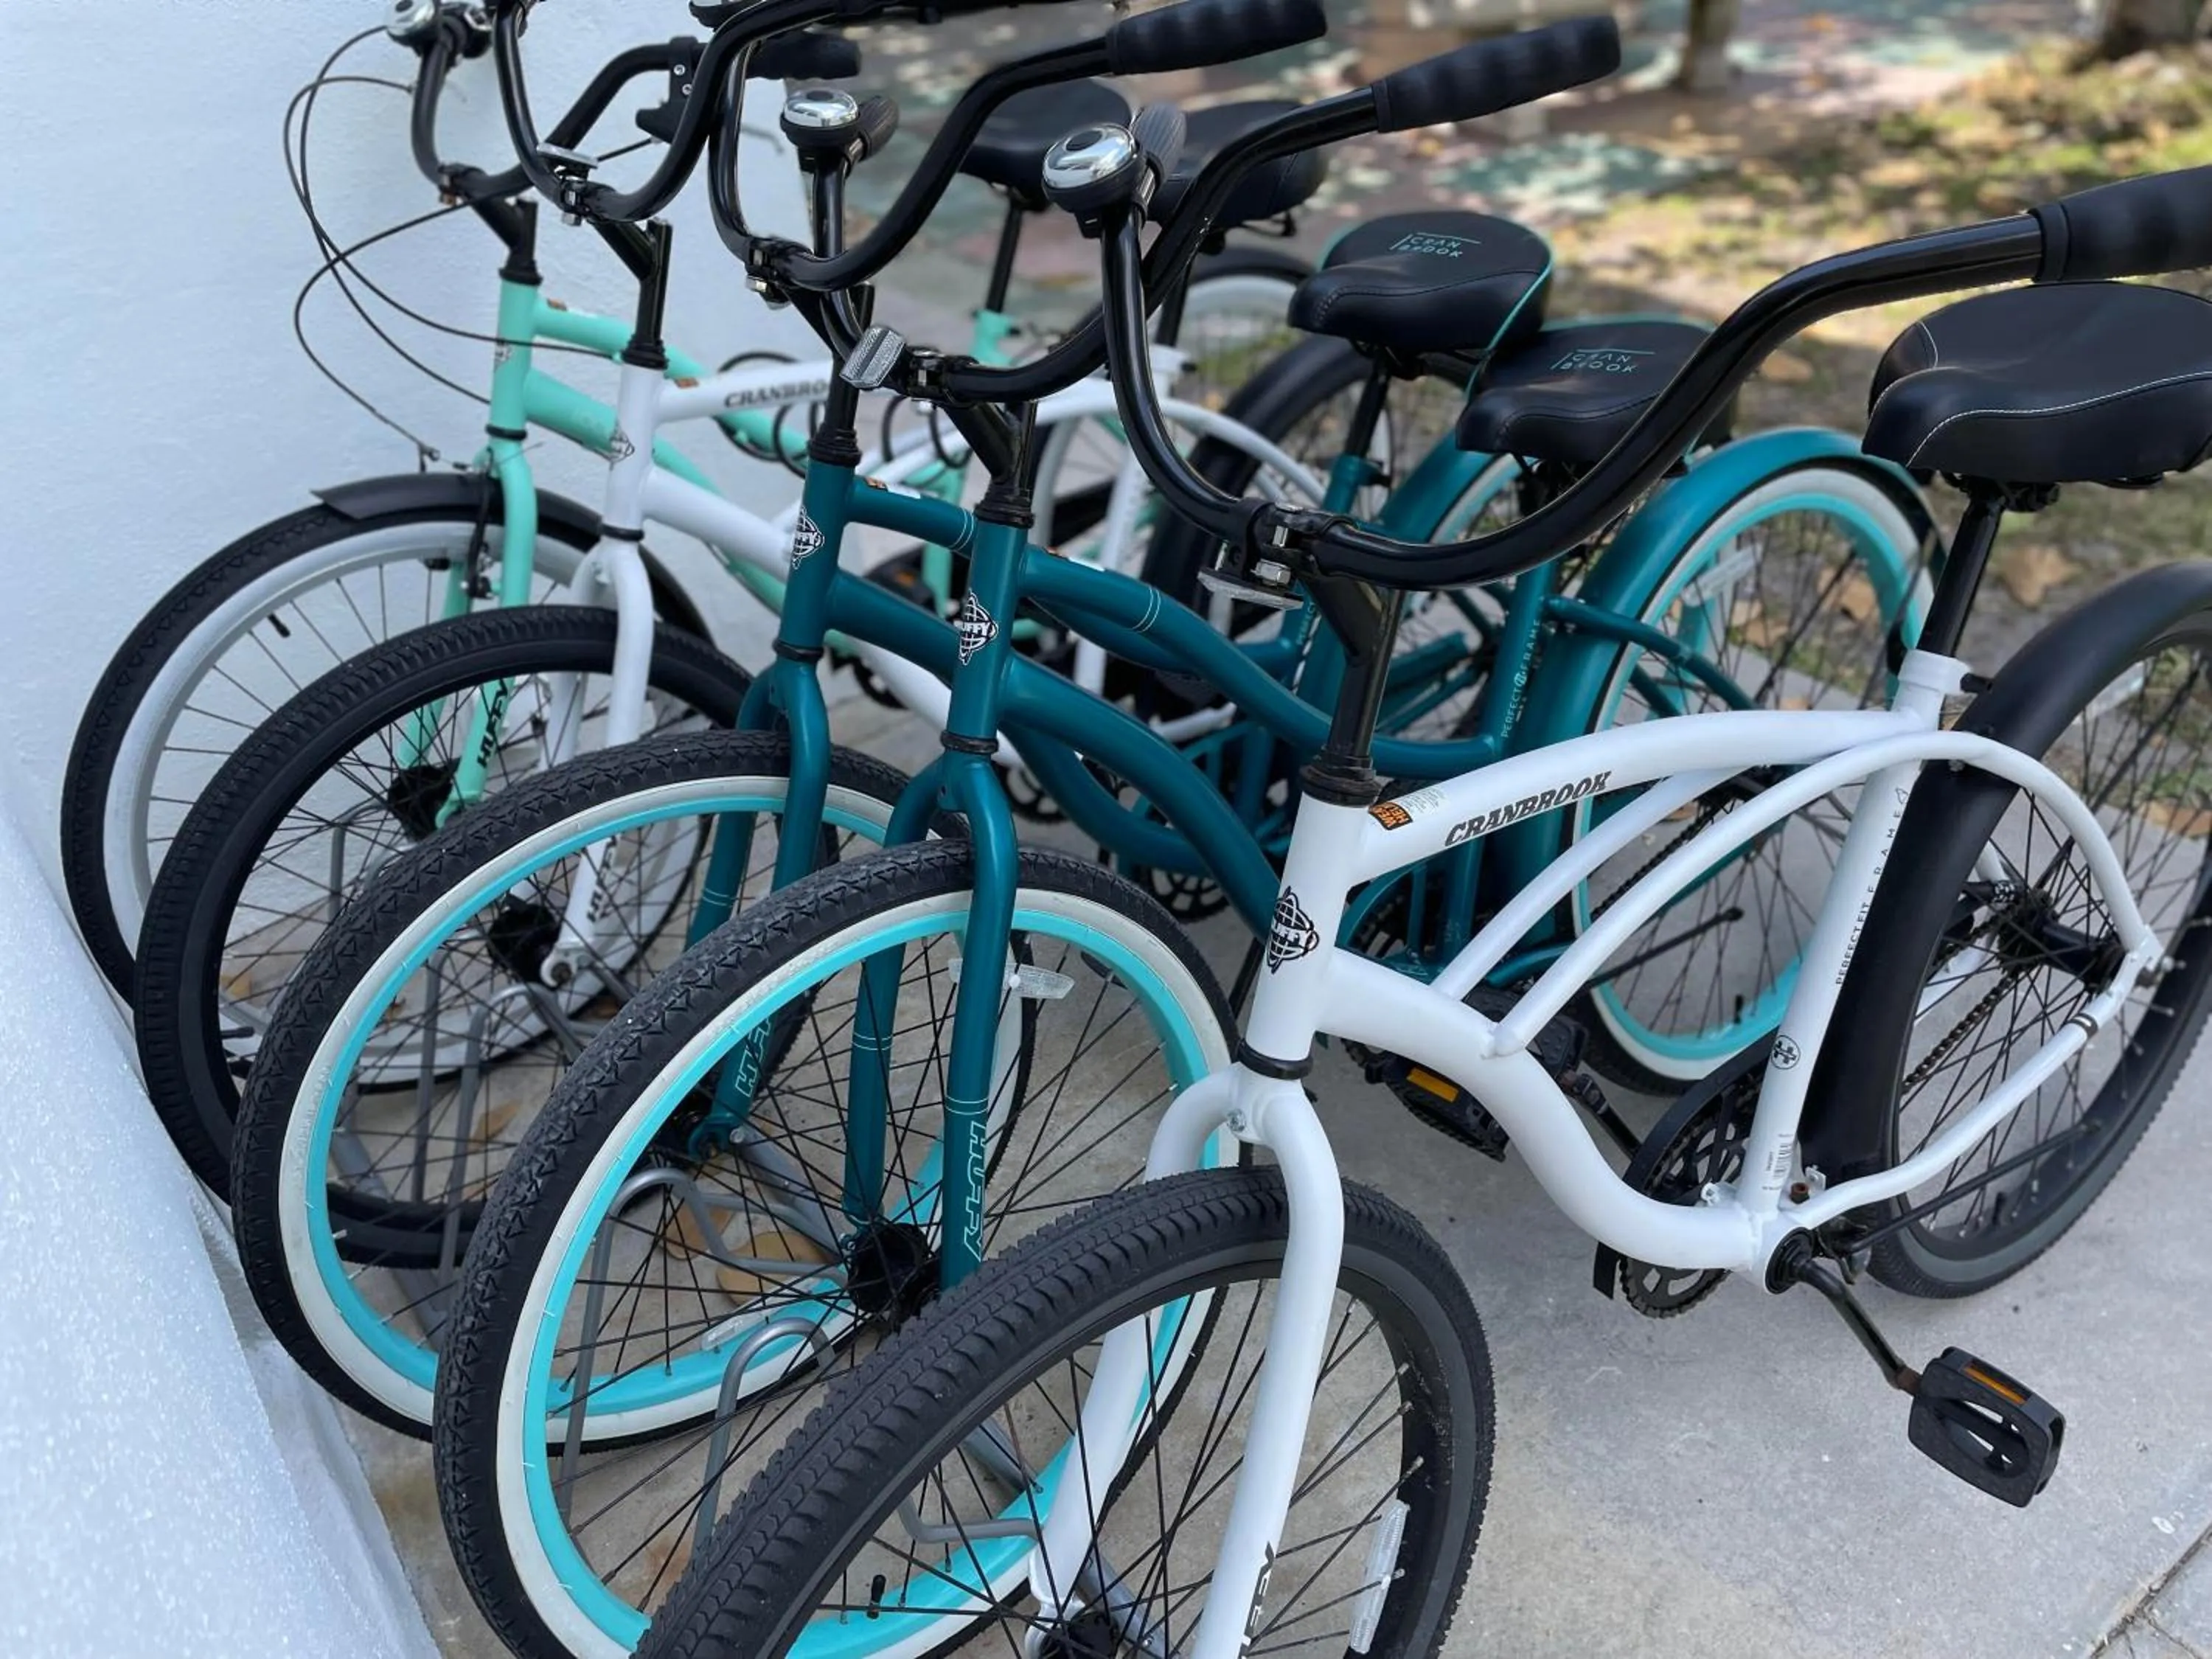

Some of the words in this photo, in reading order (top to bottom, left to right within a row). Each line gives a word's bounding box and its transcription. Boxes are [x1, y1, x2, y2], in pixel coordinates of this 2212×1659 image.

[723, 378, 829, 408] CRANBRO
[1444, 771, 1605, 847] CRANBROOK
[963, 1120, 986, 1263] HUFFY
